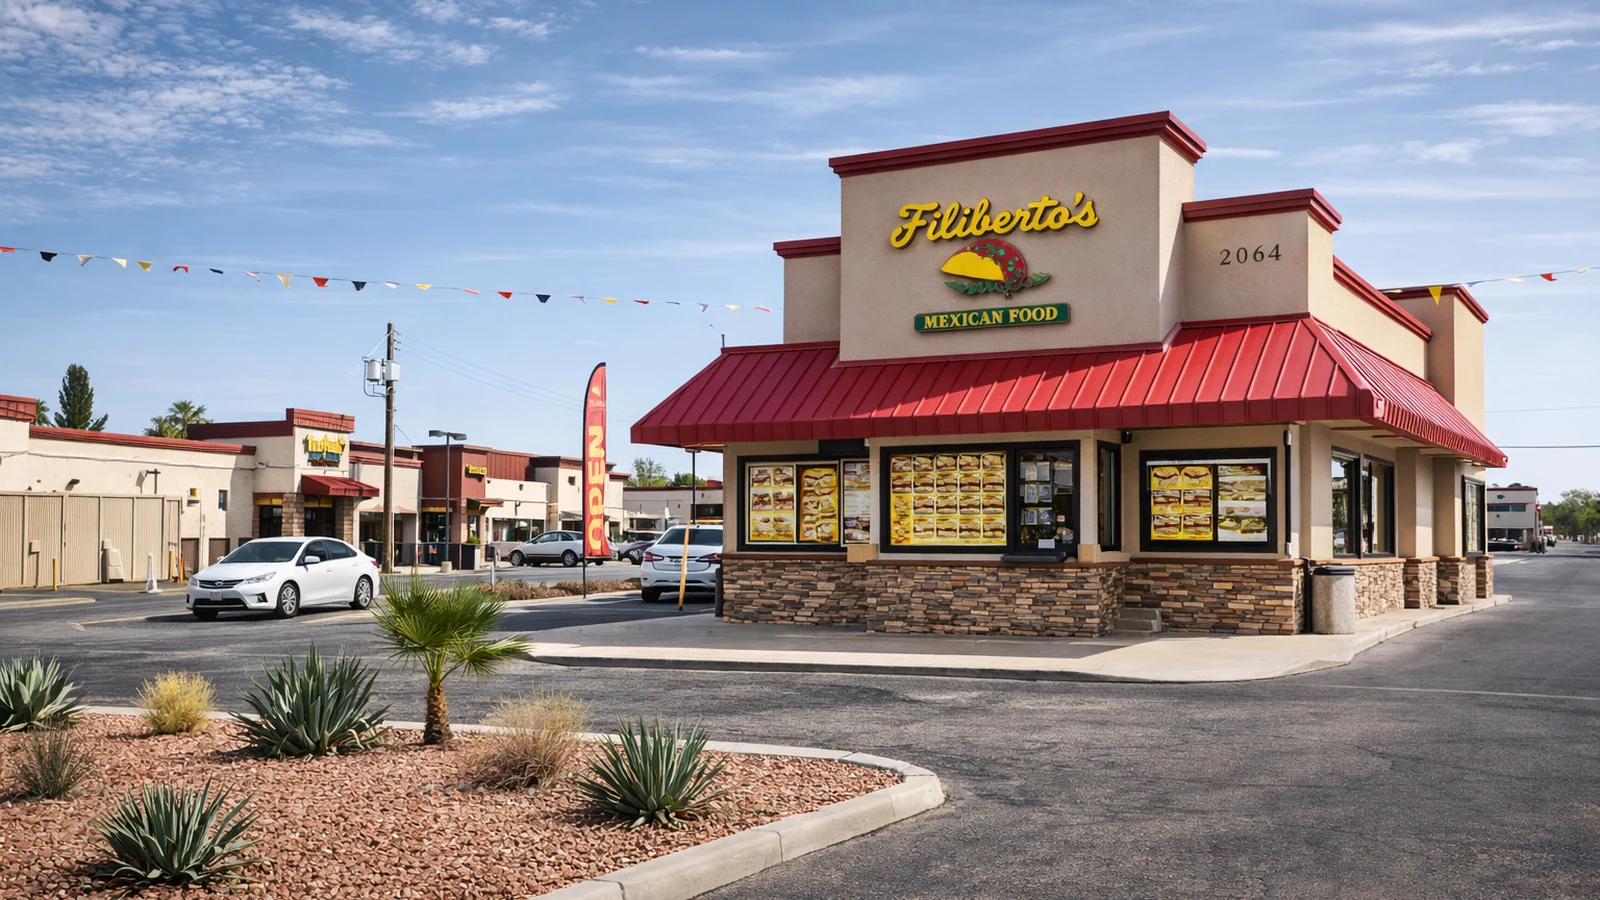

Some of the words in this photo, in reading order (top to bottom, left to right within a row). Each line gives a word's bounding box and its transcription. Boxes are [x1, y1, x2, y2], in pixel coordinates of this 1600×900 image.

[890, 191, 1099, 249] Filiberto's
[1219, 243, 1282, 266] 2064
[923, 310, 1003, 329] MEXICAN
[1009, 306, 1058, 323] FOOD
[588, 425, 605, 550] OPEN
